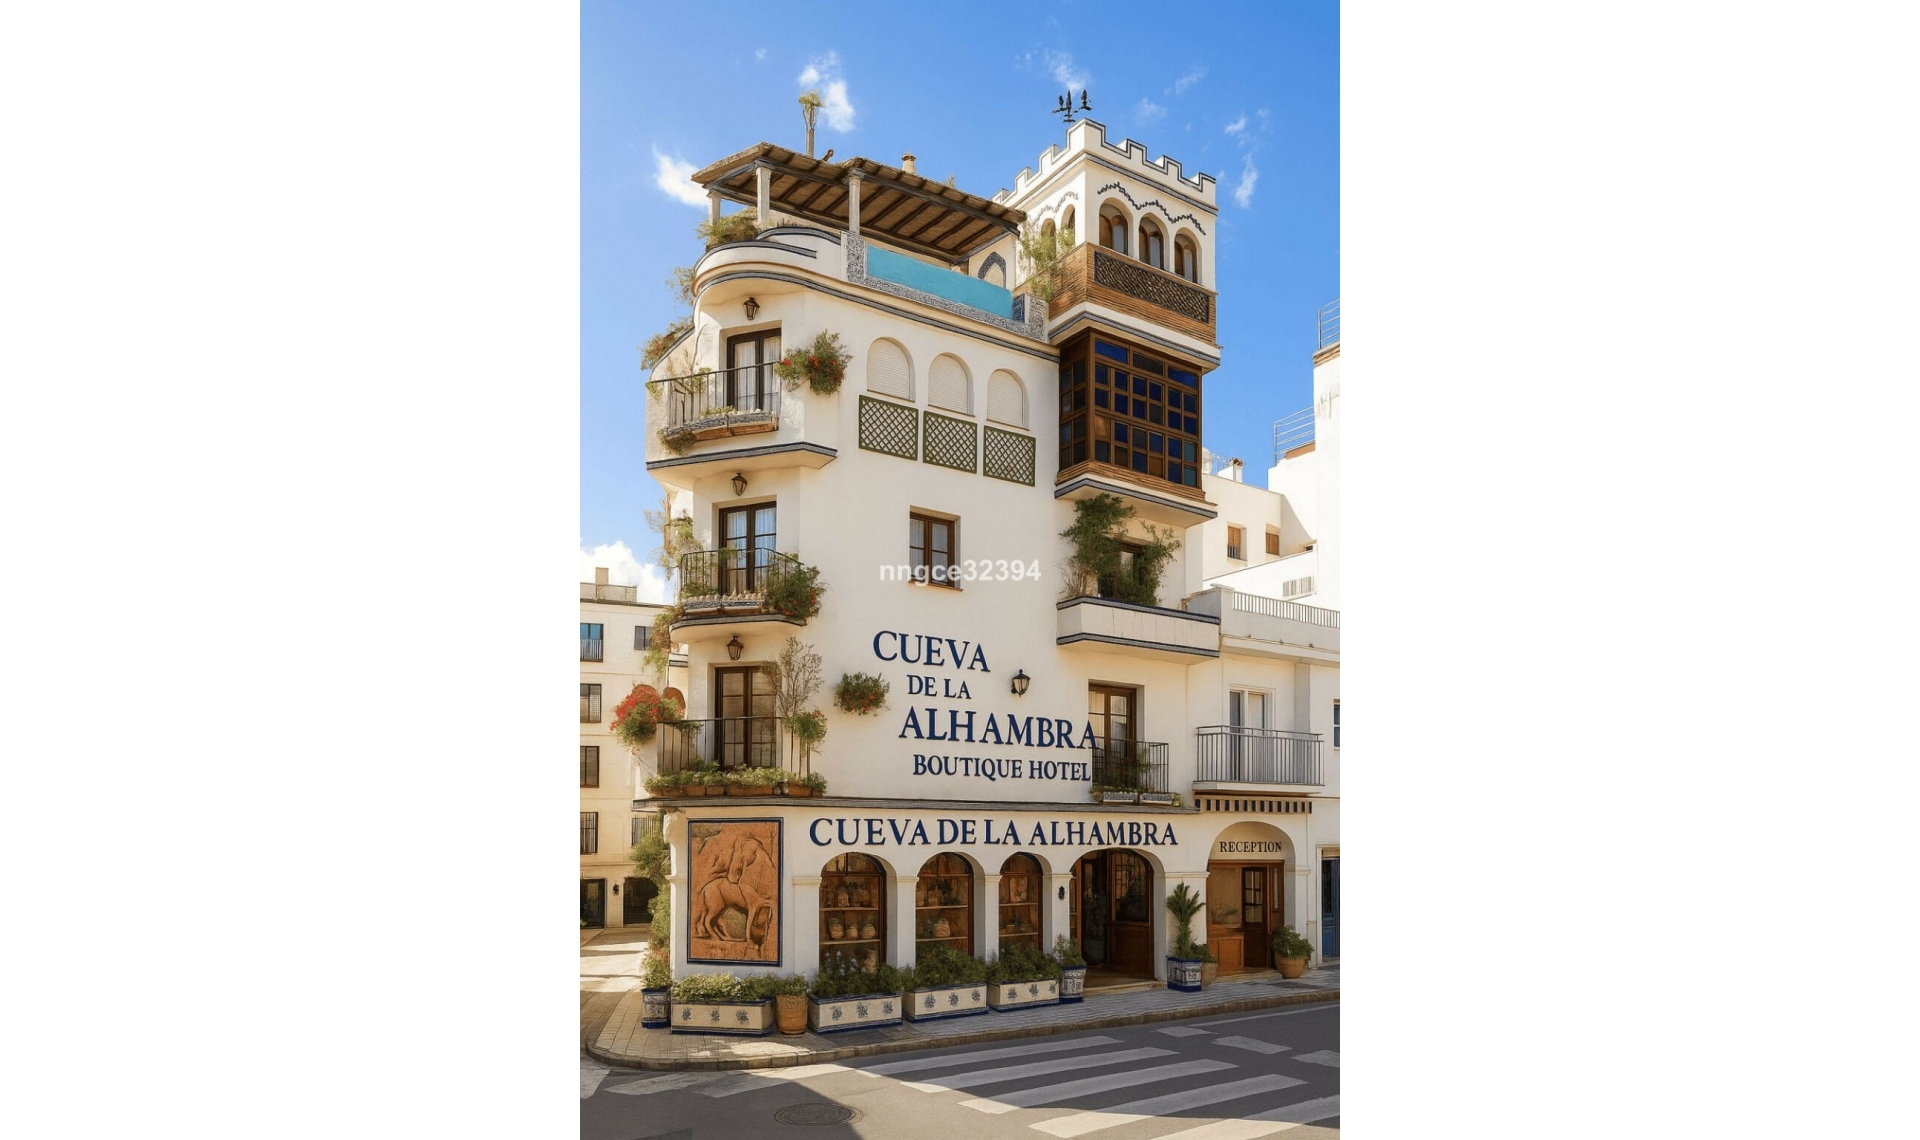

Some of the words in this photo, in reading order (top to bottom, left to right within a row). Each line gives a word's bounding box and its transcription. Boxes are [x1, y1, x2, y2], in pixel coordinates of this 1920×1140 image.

[873, 630, 991, 672] CUEVA
[907, 674, 938, 697] DE
[943, 679, 972, 700] LA
[898, 706, 1102, 750] ALHAMBRA
[913, 754, 1023, 782] BOUTIQUE
[1028, 760, 1092, 782] HOTEL
[809, 817, 932, 847] CUEVA
[937, 818, 977, 846] DE
[983, 819, 1022, 846] LA
[1028, 820, 1179, 846] ALHAMBRA
[1219, 841, 1283, 854] RECEPTION
